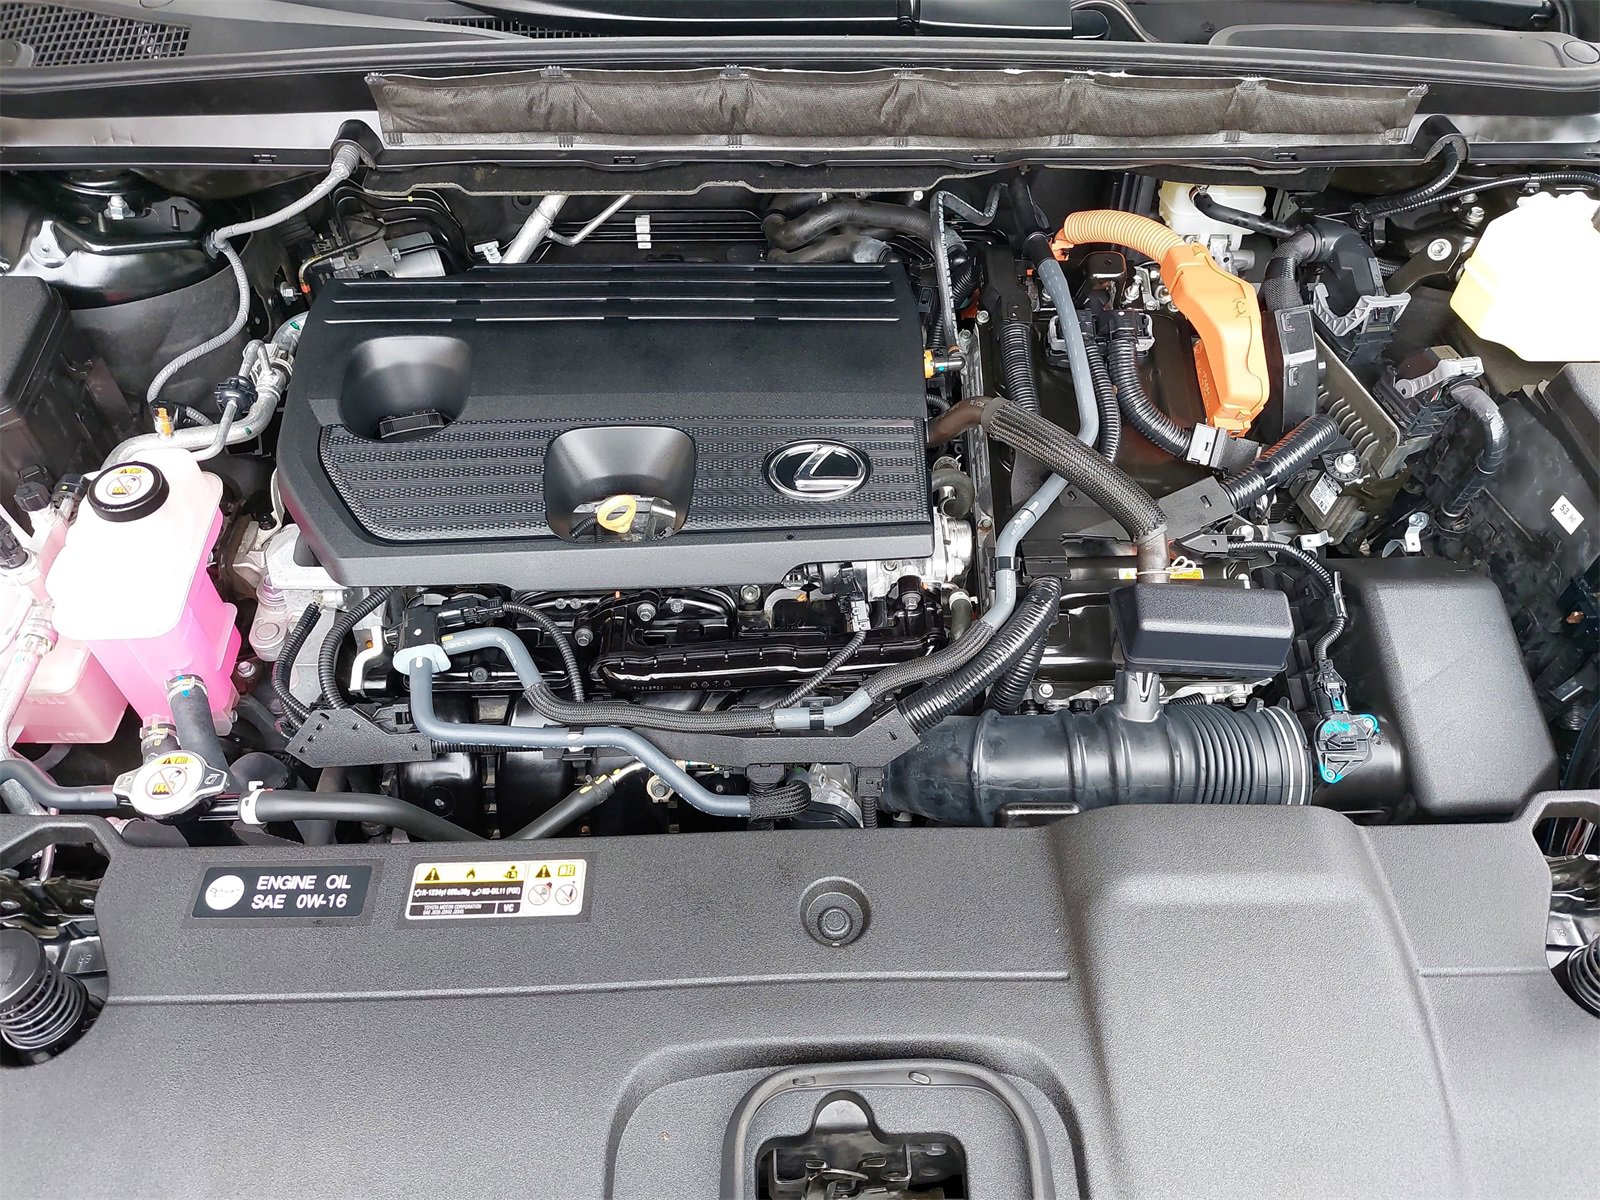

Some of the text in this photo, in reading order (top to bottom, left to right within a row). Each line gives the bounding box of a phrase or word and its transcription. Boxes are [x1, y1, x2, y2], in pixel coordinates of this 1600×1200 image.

[1559, 503, 1570, 515] 53
[256, 874, 352, 890] ENGINE OIL
[251, 893, 348, 910] SAE 0W-16
[503, 903, 514, 912] VC
